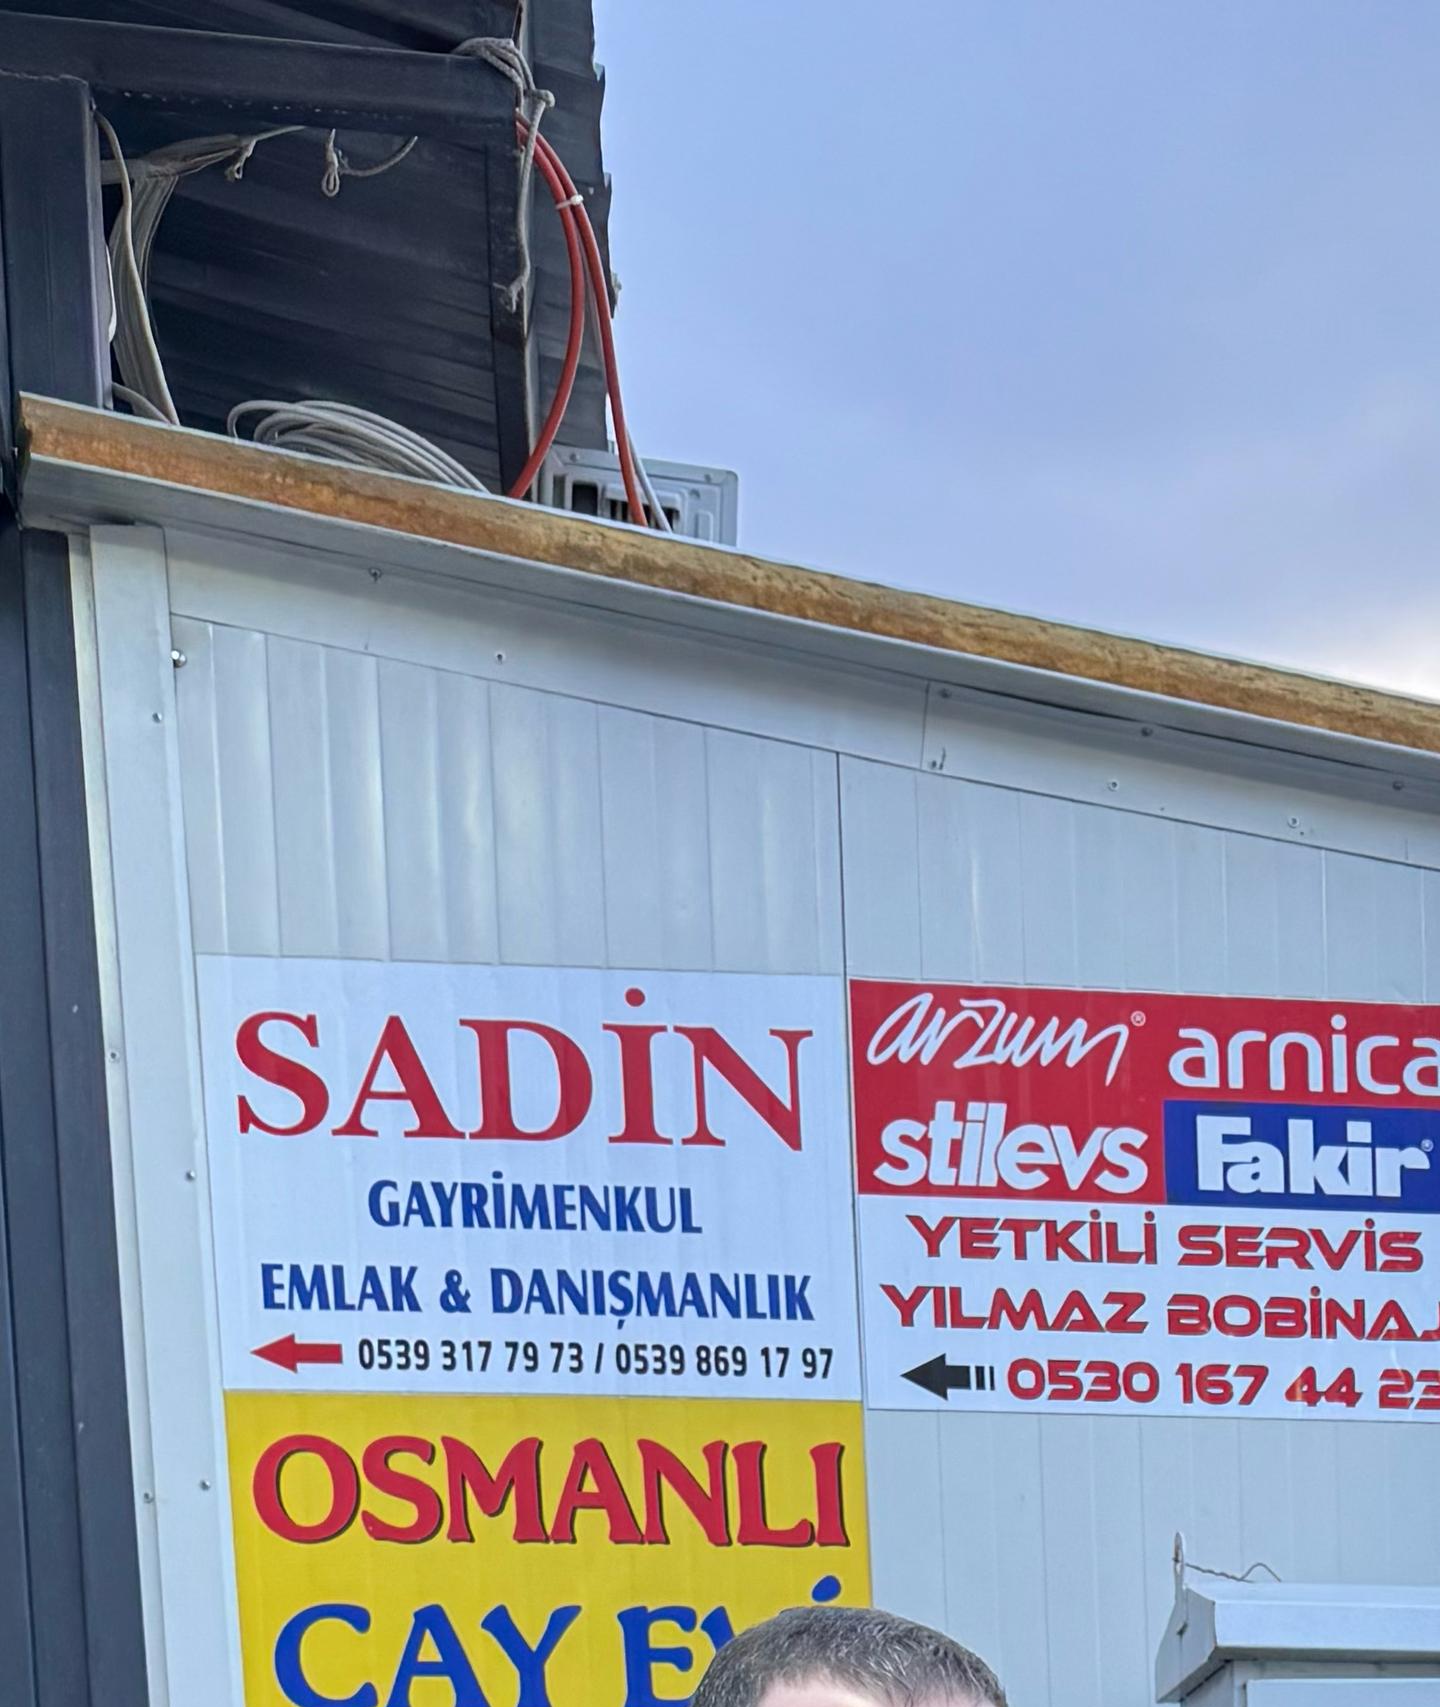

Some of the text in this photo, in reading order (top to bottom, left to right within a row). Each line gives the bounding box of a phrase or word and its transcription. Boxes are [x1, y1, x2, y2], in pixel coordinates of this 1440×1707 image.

[234, 987, 814, 1152] SADİN
[872, 1100, 1149, 1195] stilevs
[1196, 1113, 1432, 1198] Fakir
[368, 1170, 703, 1234] GAYRİMENKUL
[905, 1209, 1424, 1274] YETKİLİ SERVİS
[260, 1262, 815, 1330] EMLAK & DANIŞMANLIK
[879, 1284, 1150, 1335] YILMAZ
[358, 1338, 834, 1380] 0539 317 79 73 / 0539 869 17 97
[1006, 1357, 1160, 1405] 0530
[1175, 1362, 1270, 1407] 167
[1285, 1365, 1364, 1408] 44
[253, 1433, 852, 1548] OSMANLI
